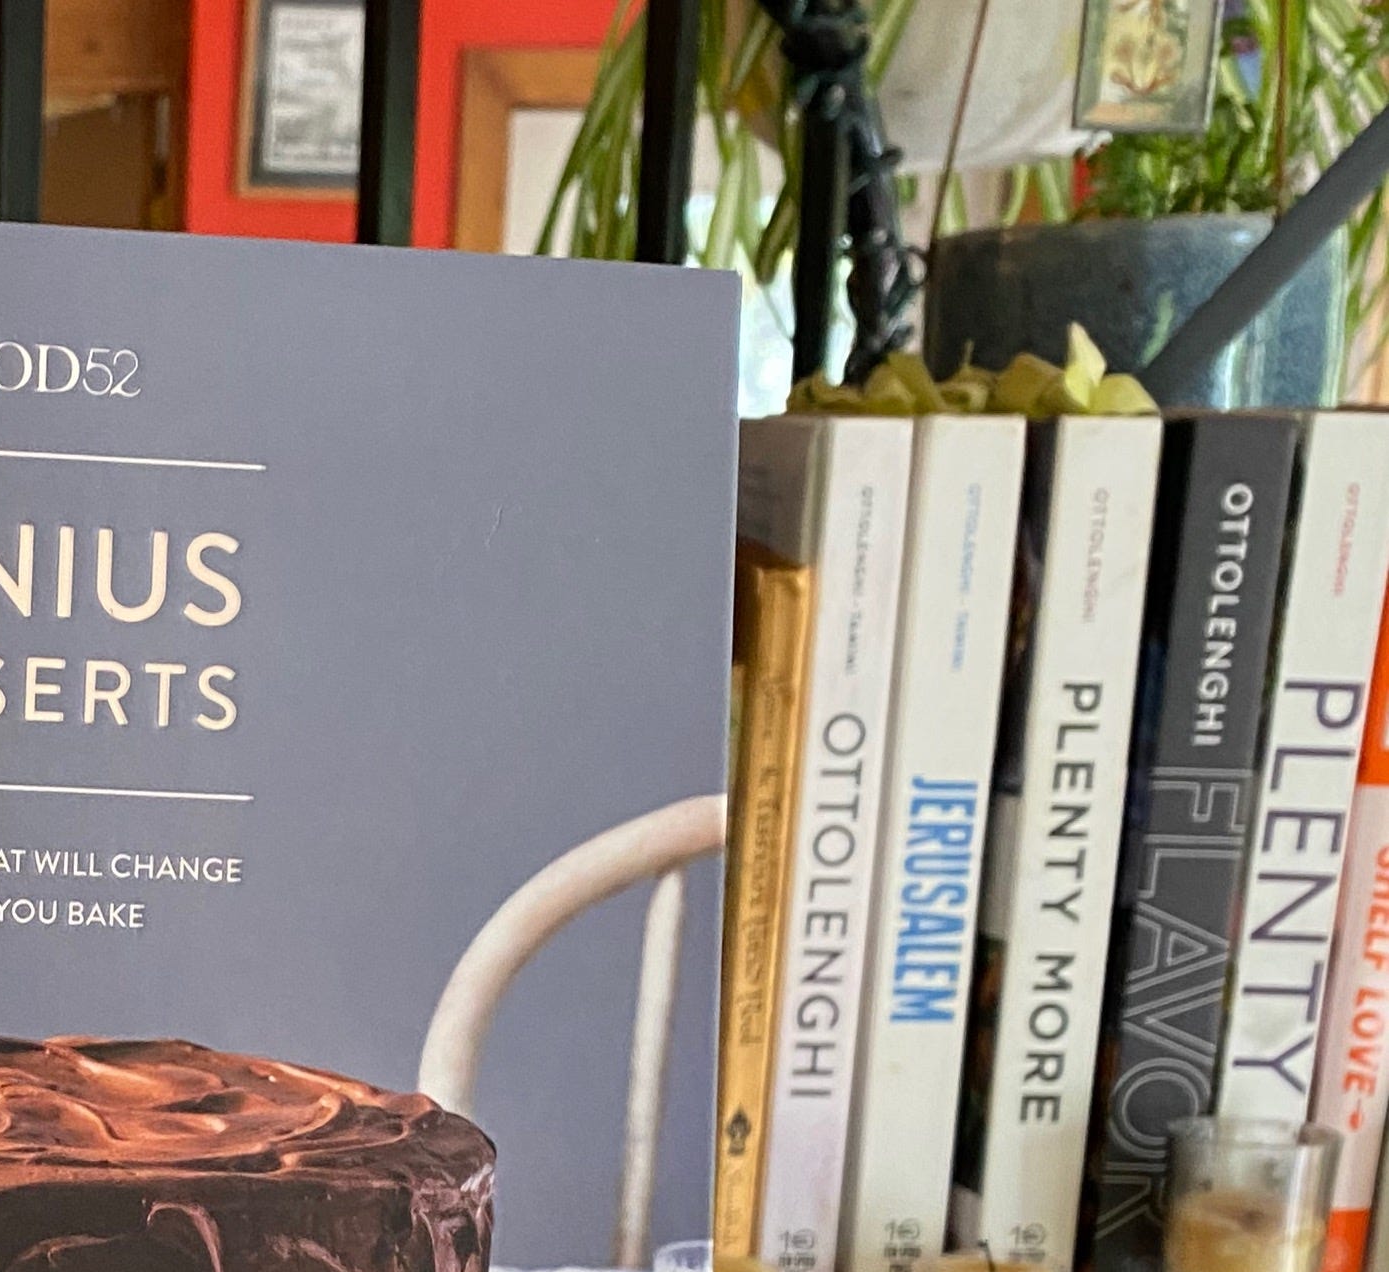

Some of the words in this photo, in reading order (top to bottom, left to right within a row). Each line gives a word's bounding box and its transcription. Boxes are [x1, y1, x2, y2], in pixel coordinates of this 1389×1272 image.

[1082, 488, 1109, 623] OTTOLENGHI
[1192, 482, 1254, 748] OTTOLENGHI
[33, 849, 103, 878] WILL
[110, 852, 243, 885] CHANGE
[789, 712, 866, 1100] OTTOLENGHI
[890, 774, 978, 1025] JERUSALEM
[1039, 682, 1104, 925] PLENTY
[1233, 680, 1366, 1094] PLENTY
[67, 901, 146, 929] BAKE
[1020, 953, 1076, 1124] MORE
[1342, 986, 1384, 1100] LOVE
